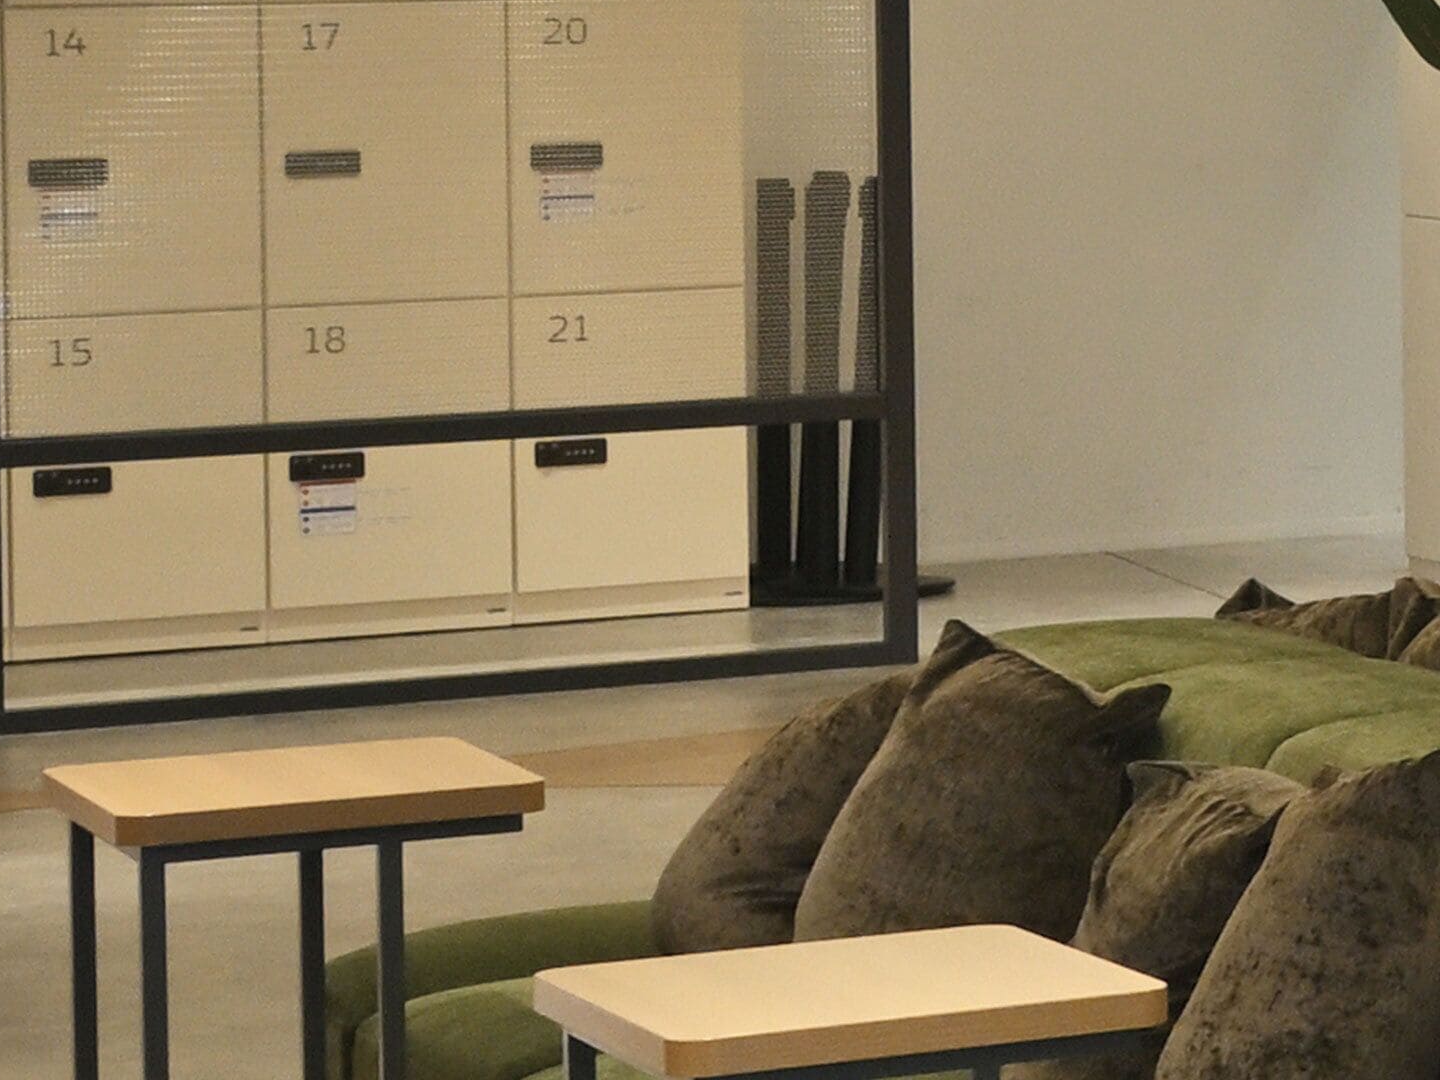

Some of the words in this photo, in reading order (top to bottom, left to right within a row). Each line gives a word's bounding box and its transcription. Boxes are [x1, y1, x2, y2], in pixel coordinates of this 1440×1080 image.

[45, 28, 87, 57] 14
[302, 22, 340, 51] 17
[543, 17, 588, 45] 20
[304, 325, 346, 354] 18
[548, 315, 588, 344] 21
[49, 338, 92, 367] 15
